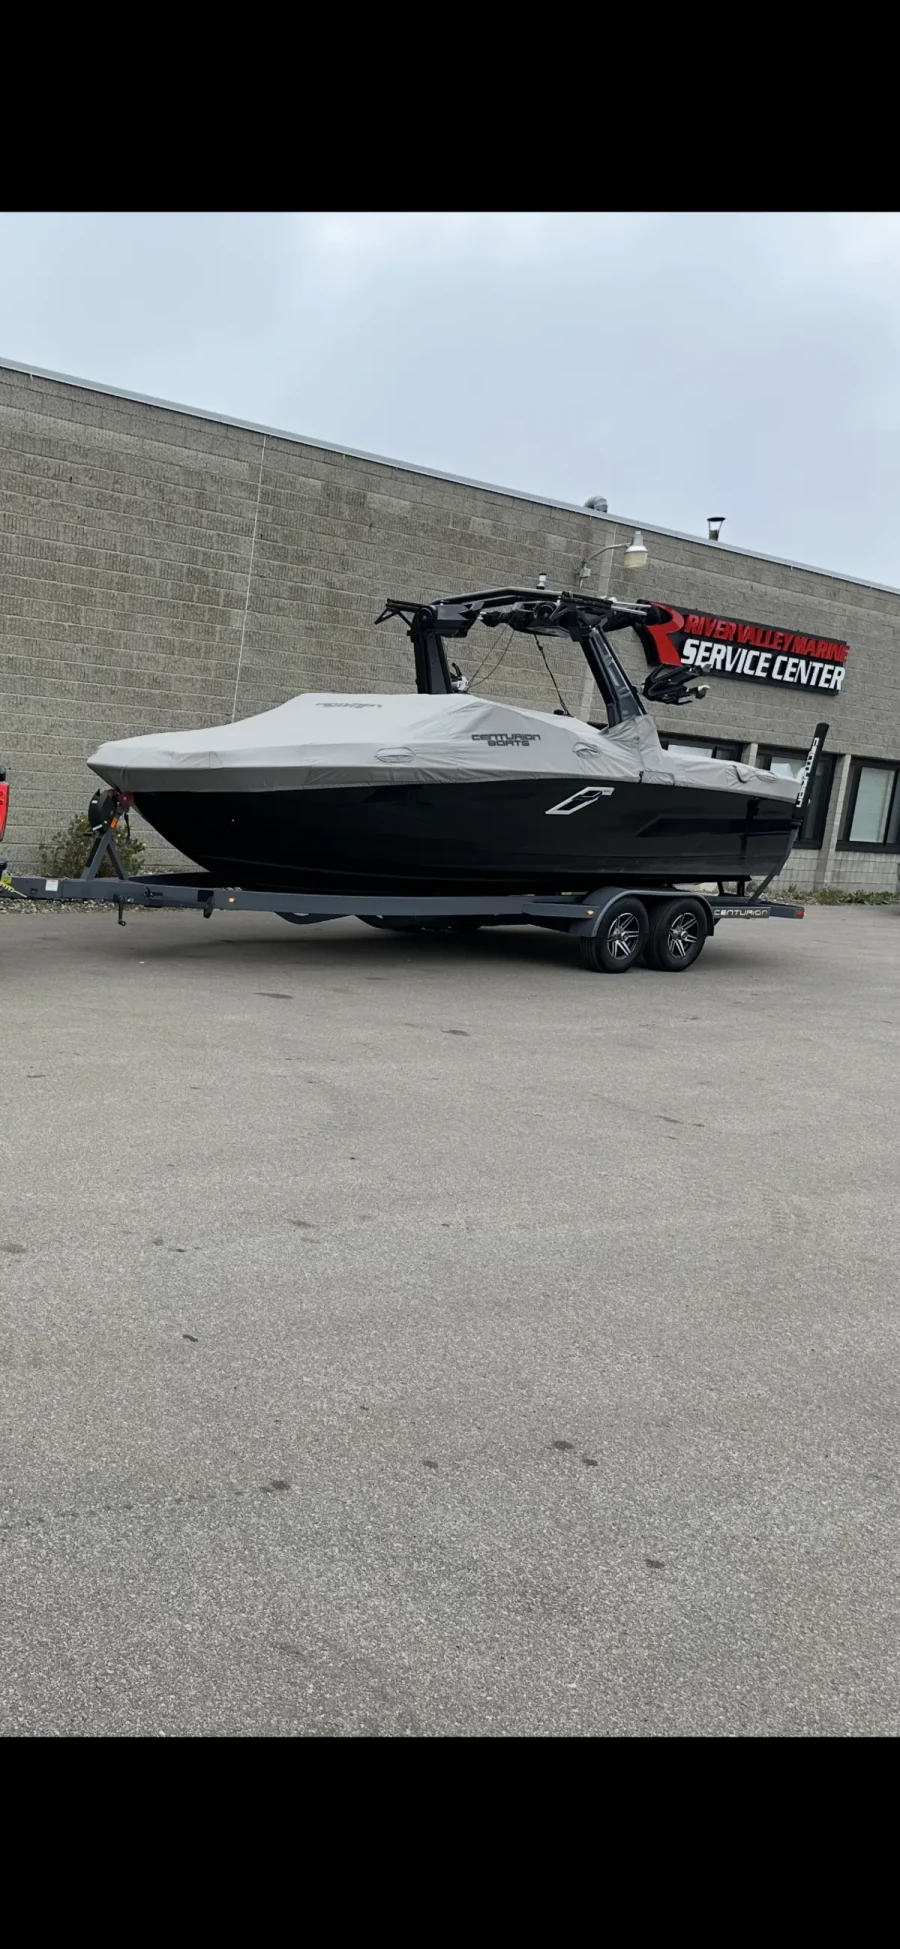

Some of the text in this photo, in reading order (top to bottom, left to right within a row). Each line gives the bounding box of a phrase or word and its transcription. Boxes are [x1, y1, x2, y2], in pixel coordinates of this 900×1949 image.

[684, 614, 850, 663] RIVER VALLEY MARINE
[681, 638, 845, 690] SERVICE CENTER
